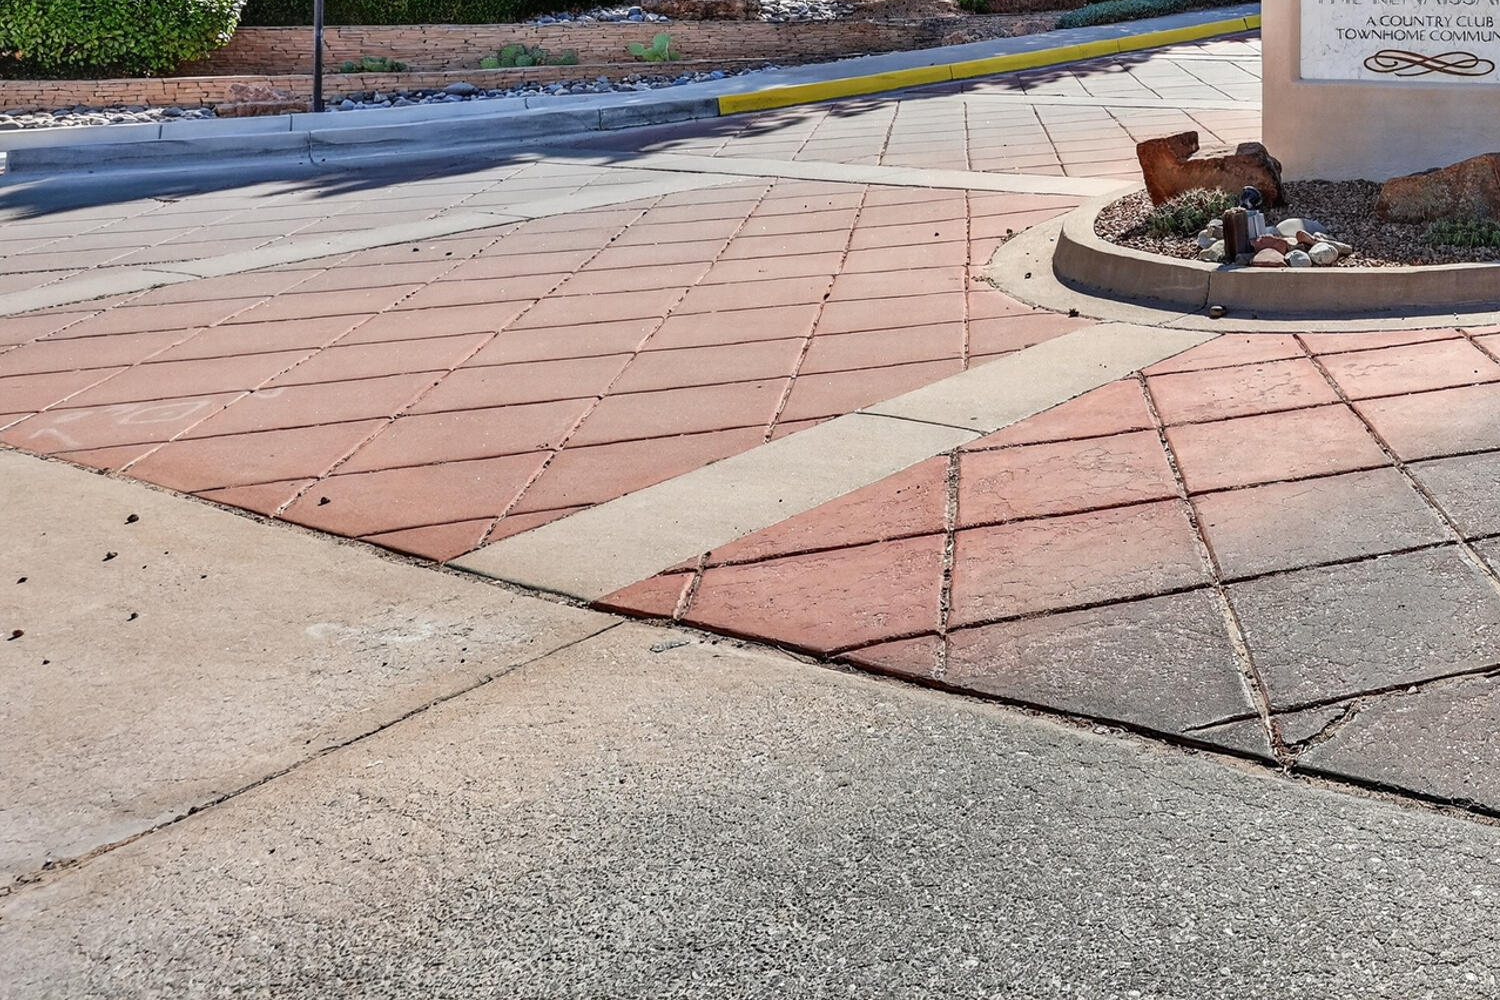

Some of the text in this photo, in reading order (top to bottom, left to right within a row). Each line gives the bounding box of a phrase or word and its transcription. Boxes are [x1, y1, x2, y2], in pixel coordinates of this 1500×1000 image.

[1366, 15, 1494, 28] A COUNTRY CLUB
[1336, 28, 1426, 41] TOWNHOME
